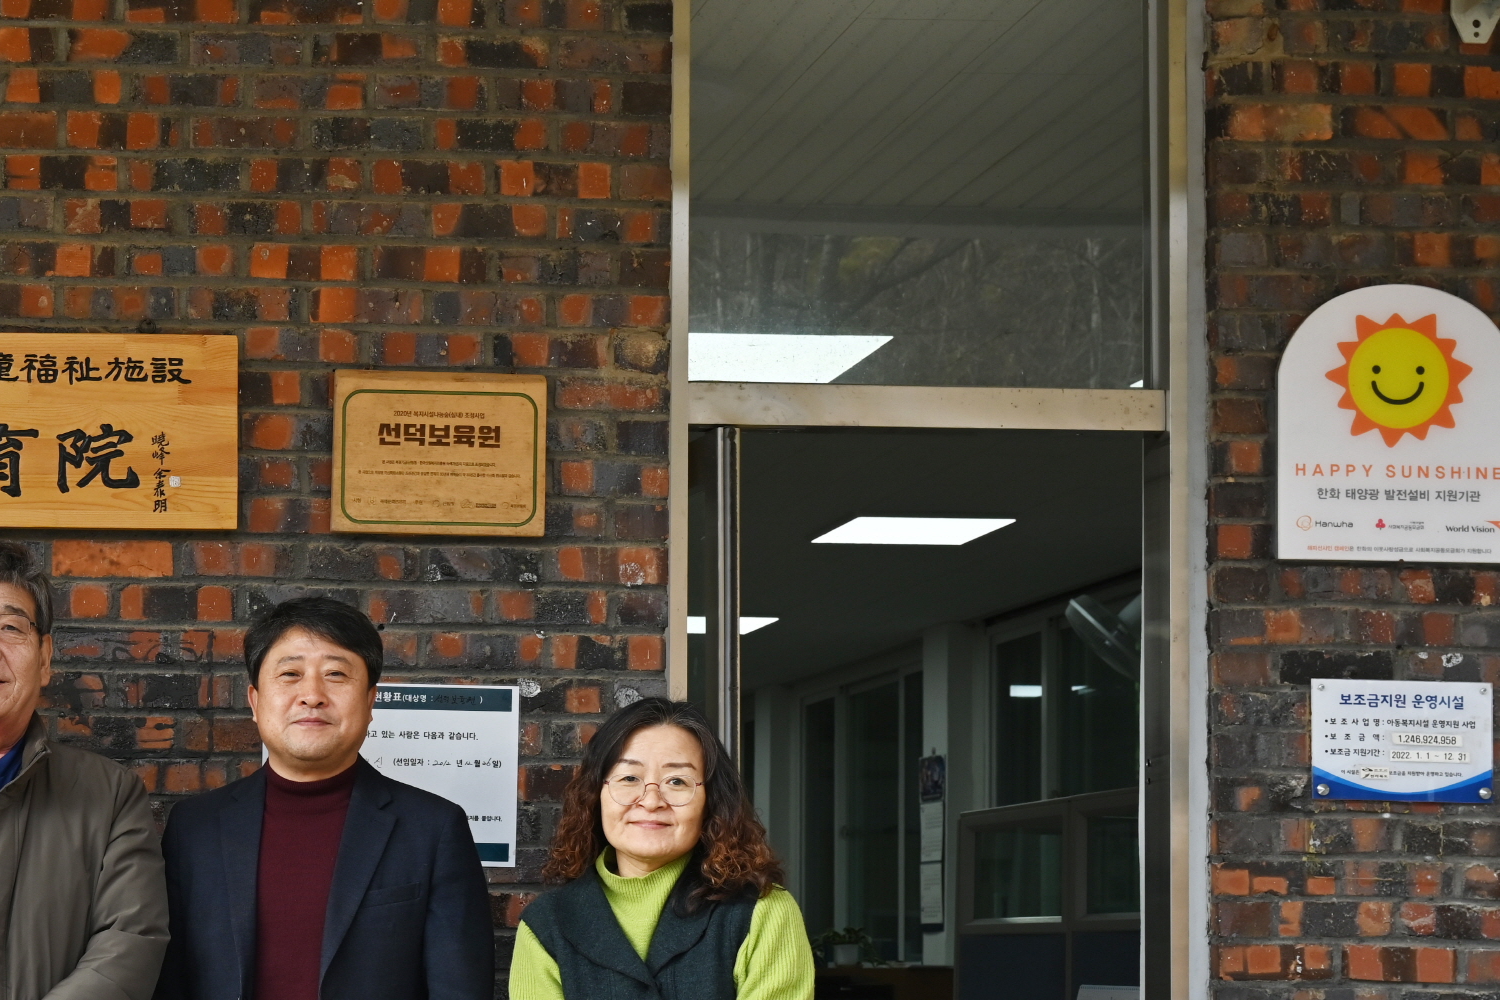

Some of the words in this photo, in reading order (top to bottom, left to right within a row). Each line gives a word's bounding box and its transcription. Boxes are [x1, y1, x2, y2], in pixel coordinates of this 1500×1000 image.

[378, 423, 501, 448] 선덕보육원
[1295, 463, 1373, 478] HAPPY
[1385, 464, 1500, 480] SUNSHINE
[1317, 488, 1340, 500] 한화
[1346, 488, 1379, 500] 태양광
[1384, 489, 1430, 502] 발전설비
[1435, 490, 1481, 502] 지원기관
[1314, 520, 1354, 528] Hanwha
[1472, 525, 1495, 533] Vision
[1339, 694, 1407, 708] 보조금지원
[1412, 694, 1464, 710] 운영시설
[1386, 719, 1430, 728] 아동복지시설
[1432, 720, 1460, 728] 운영지원
[1462, 720, 1476, 729] 사업
[382, 730, 396, 738] 있는
[399, 731, 420, 740] 사람은
[424, 732, 444, 740] 다음과
[448, 732, 478, 740] 같습니다.
[1330, 748, 1351, 756] 보조금
[1353, 748, 1380, 757] 지원기간
[1392, 751, 1412, 760] 2022.
[393, 758, 424, 766] (선임일자
[456, 759, 462, 767] 년
